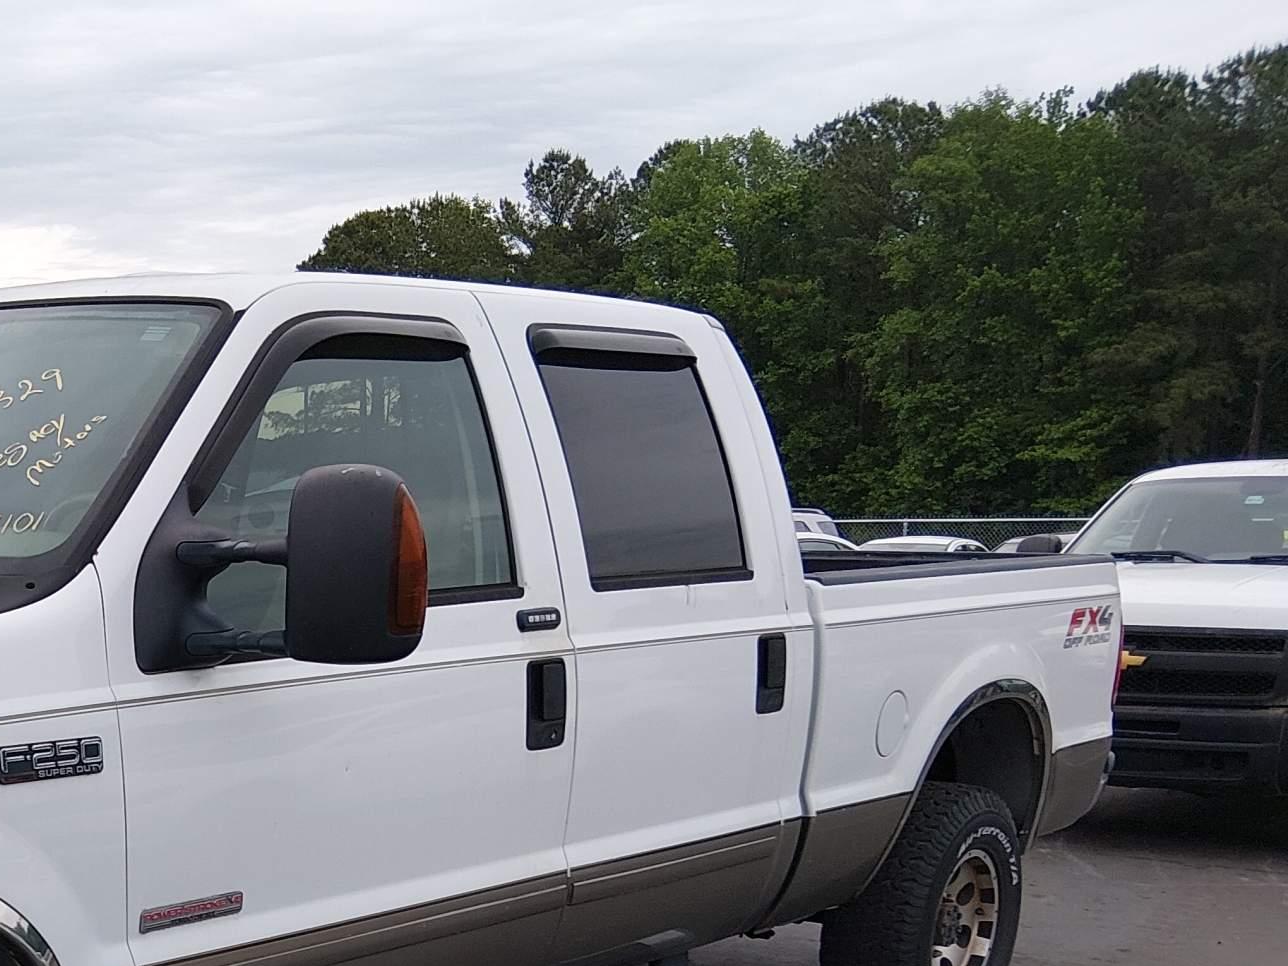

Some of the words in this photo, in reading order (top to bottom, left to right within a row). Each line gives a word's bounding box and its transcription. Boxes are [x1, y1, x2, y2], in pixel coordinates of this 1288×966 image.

[1066, 604, 1114, 637] FX4
[38, 767, 73, 778] SUPER
[76, 763, 103, 773] DUTY
